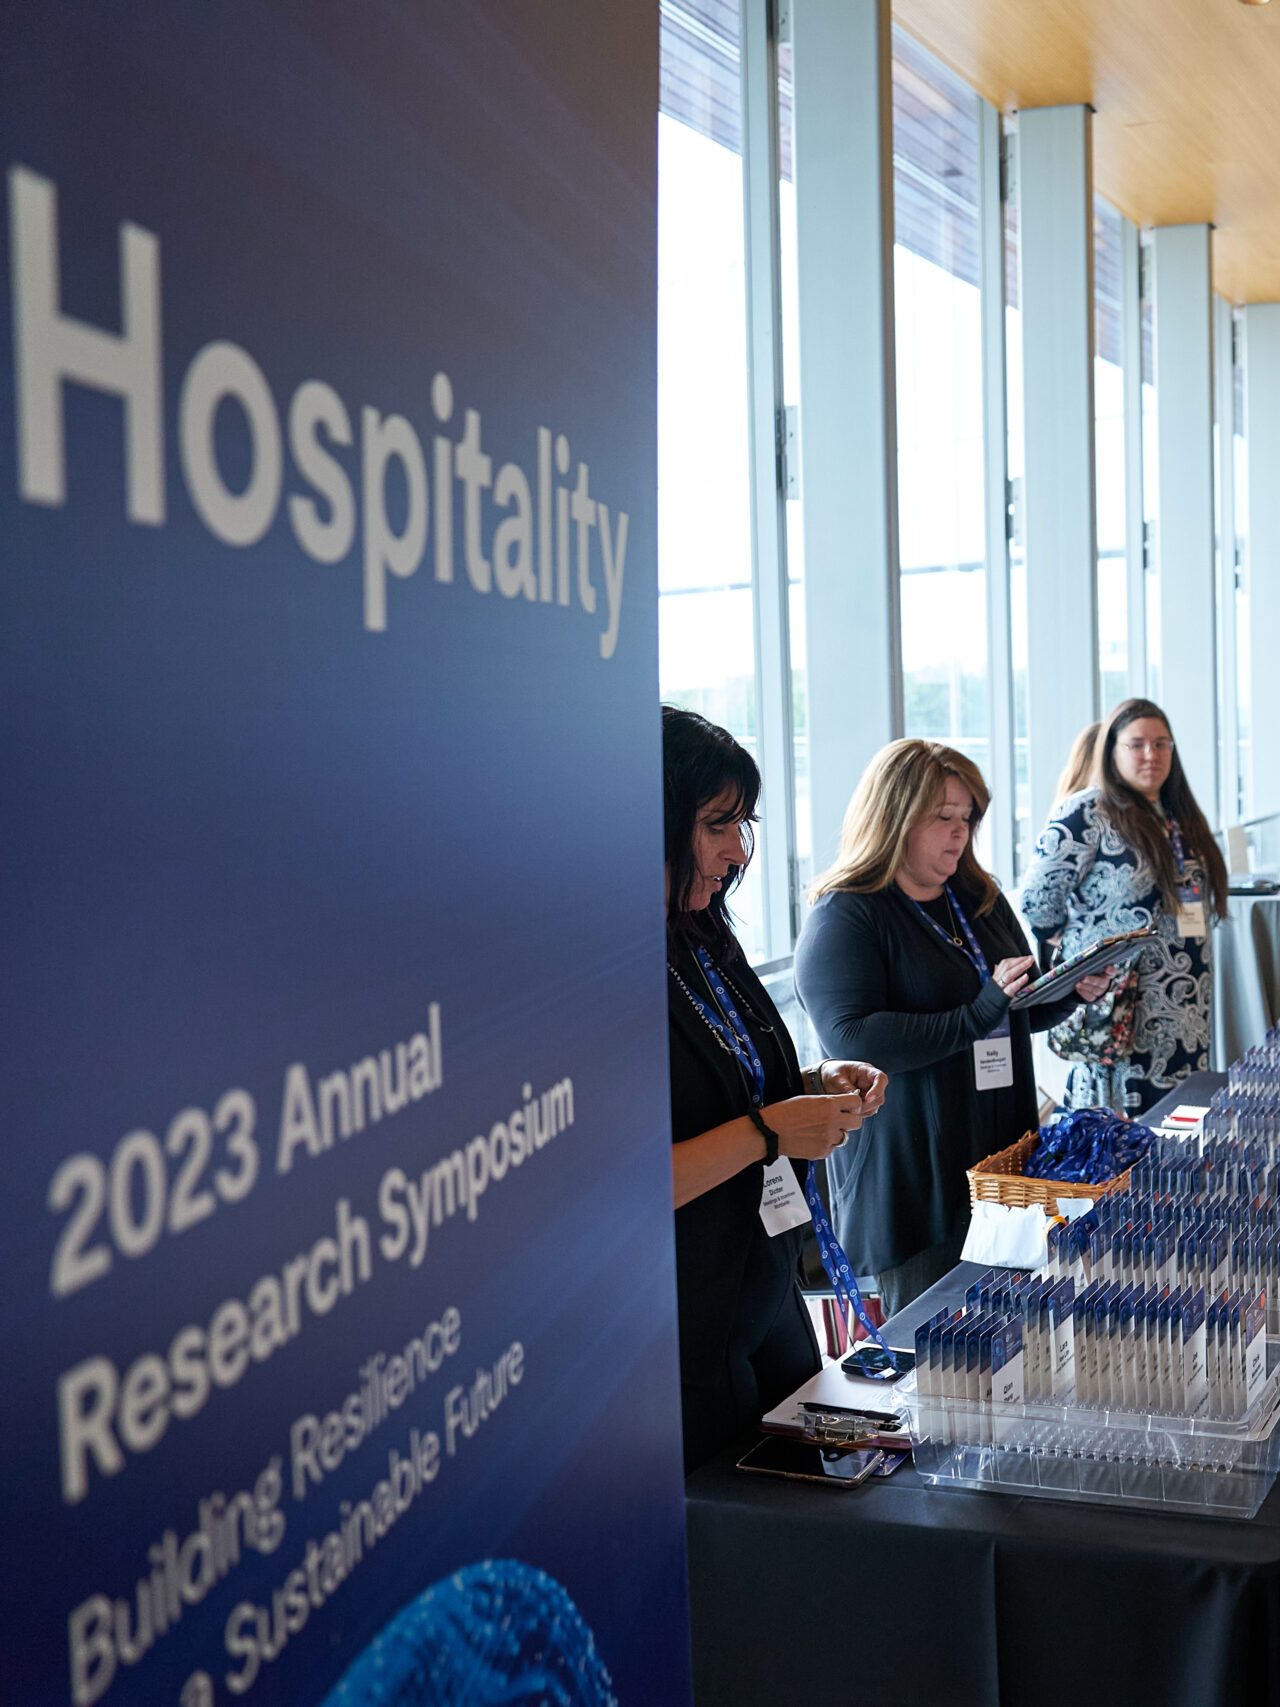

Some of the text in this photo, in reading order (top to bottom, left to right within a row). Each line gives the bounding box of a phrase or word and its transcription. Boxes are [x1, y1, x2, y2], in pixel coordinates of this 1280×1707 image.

[9, 165, 630, 660] Hospitality
[50, 1002, 443, 1296] 2023 Annual
[60, 1077, 575, 1502] Research Symposium
[69, 1307, 461, 1706] Building Resilience
[225, 1431, 440, 1694] Sustainable
[444, 1342, 524, 1455] Future
